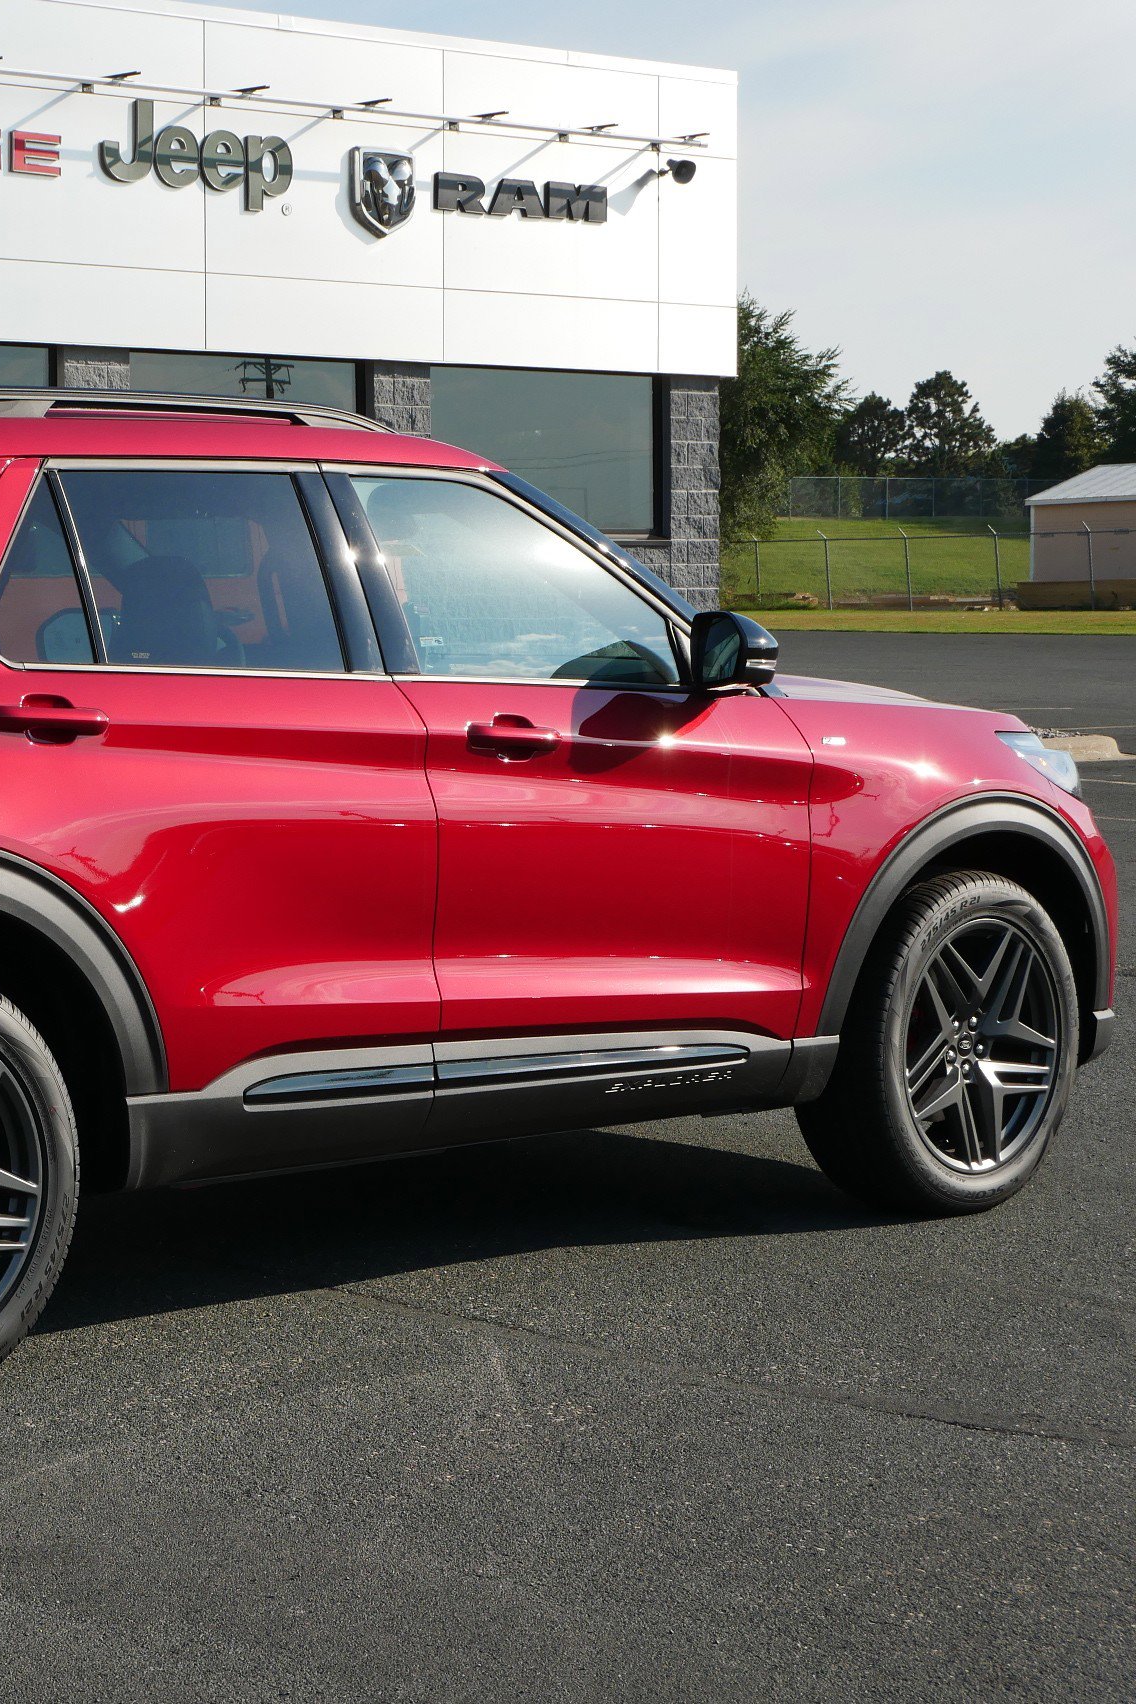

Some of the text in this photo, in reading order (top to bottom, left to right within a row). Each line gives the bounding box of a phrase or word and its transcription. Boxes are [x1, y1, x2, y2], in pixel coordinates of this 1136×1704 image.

[98, 99, 293, 212] Jeep
[433, 171, 608, 224] RAM
[959, 895, 981, 910] R21
[605, 1070, 732, 1094] EXPLORER
